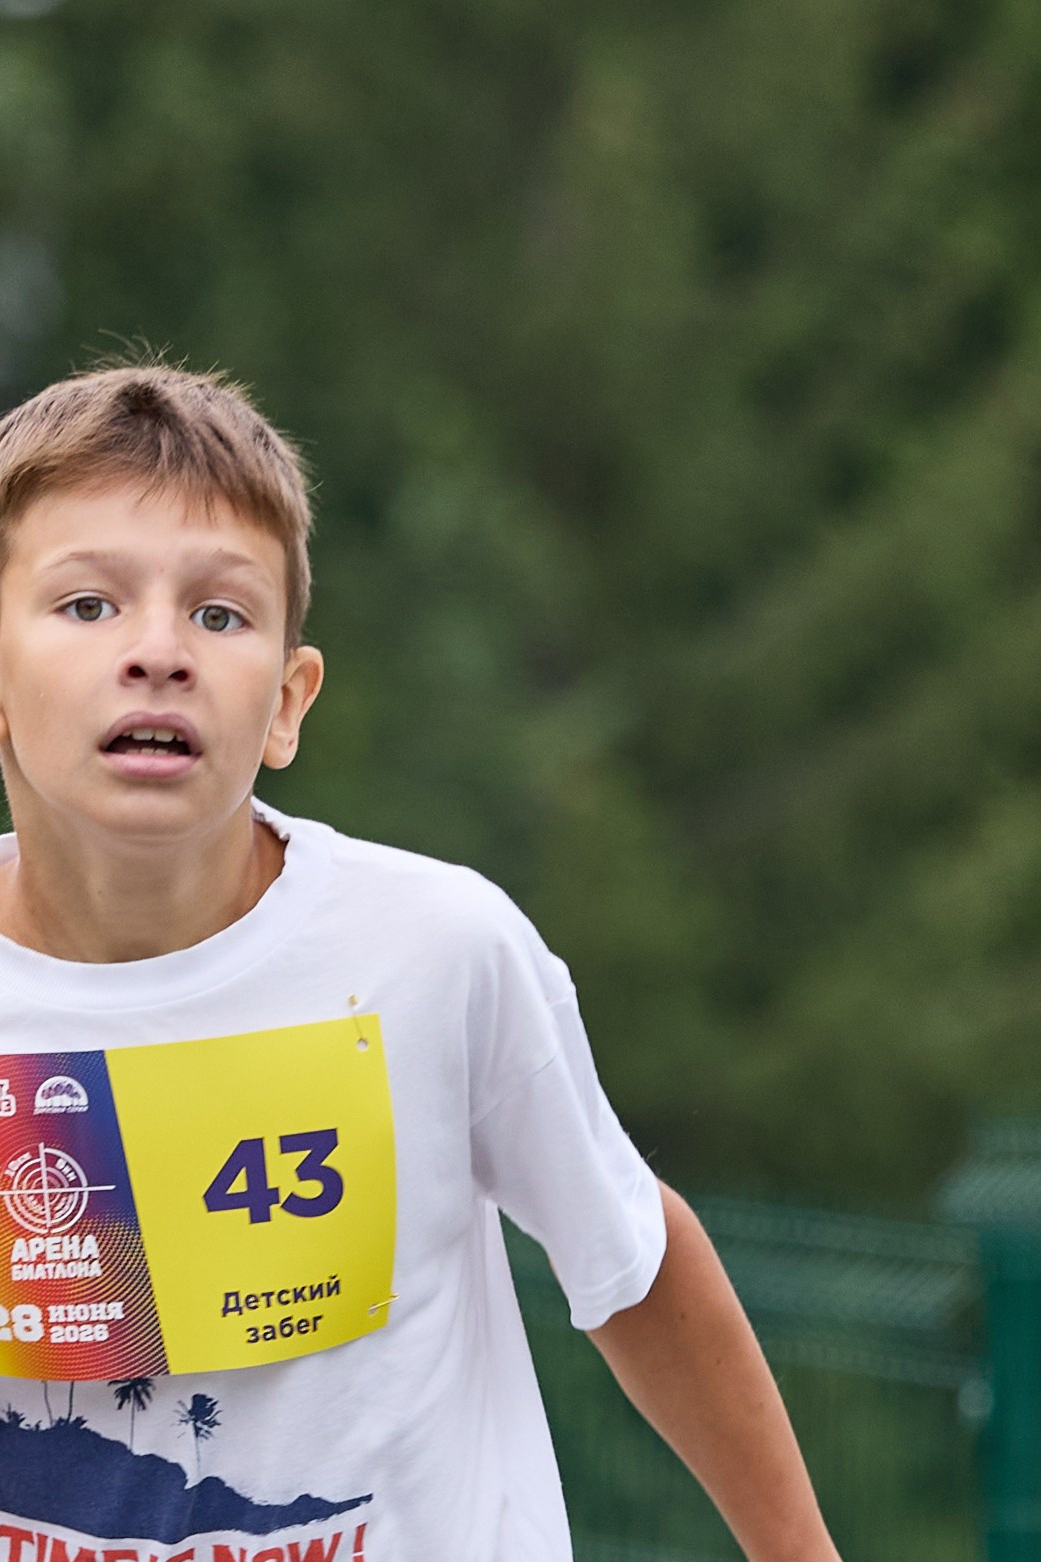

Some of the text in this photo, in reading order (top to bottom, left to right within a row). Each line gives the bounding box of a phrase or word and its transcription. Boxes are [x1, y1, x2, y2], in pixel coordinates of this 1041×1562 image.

[203, 1128, 344, 1224] 43
[10, 1234, 100, 1262] АРЕНА
[11, 1260, 102, 1281] БИАТЛОНА
[221, 1274, 341, 1318] Детский
[47, 1301, 125, 1323] ИЮНЯ
[49, 1323, 109, 1343] 2026
[246, 1315, 323, 1344] забег
